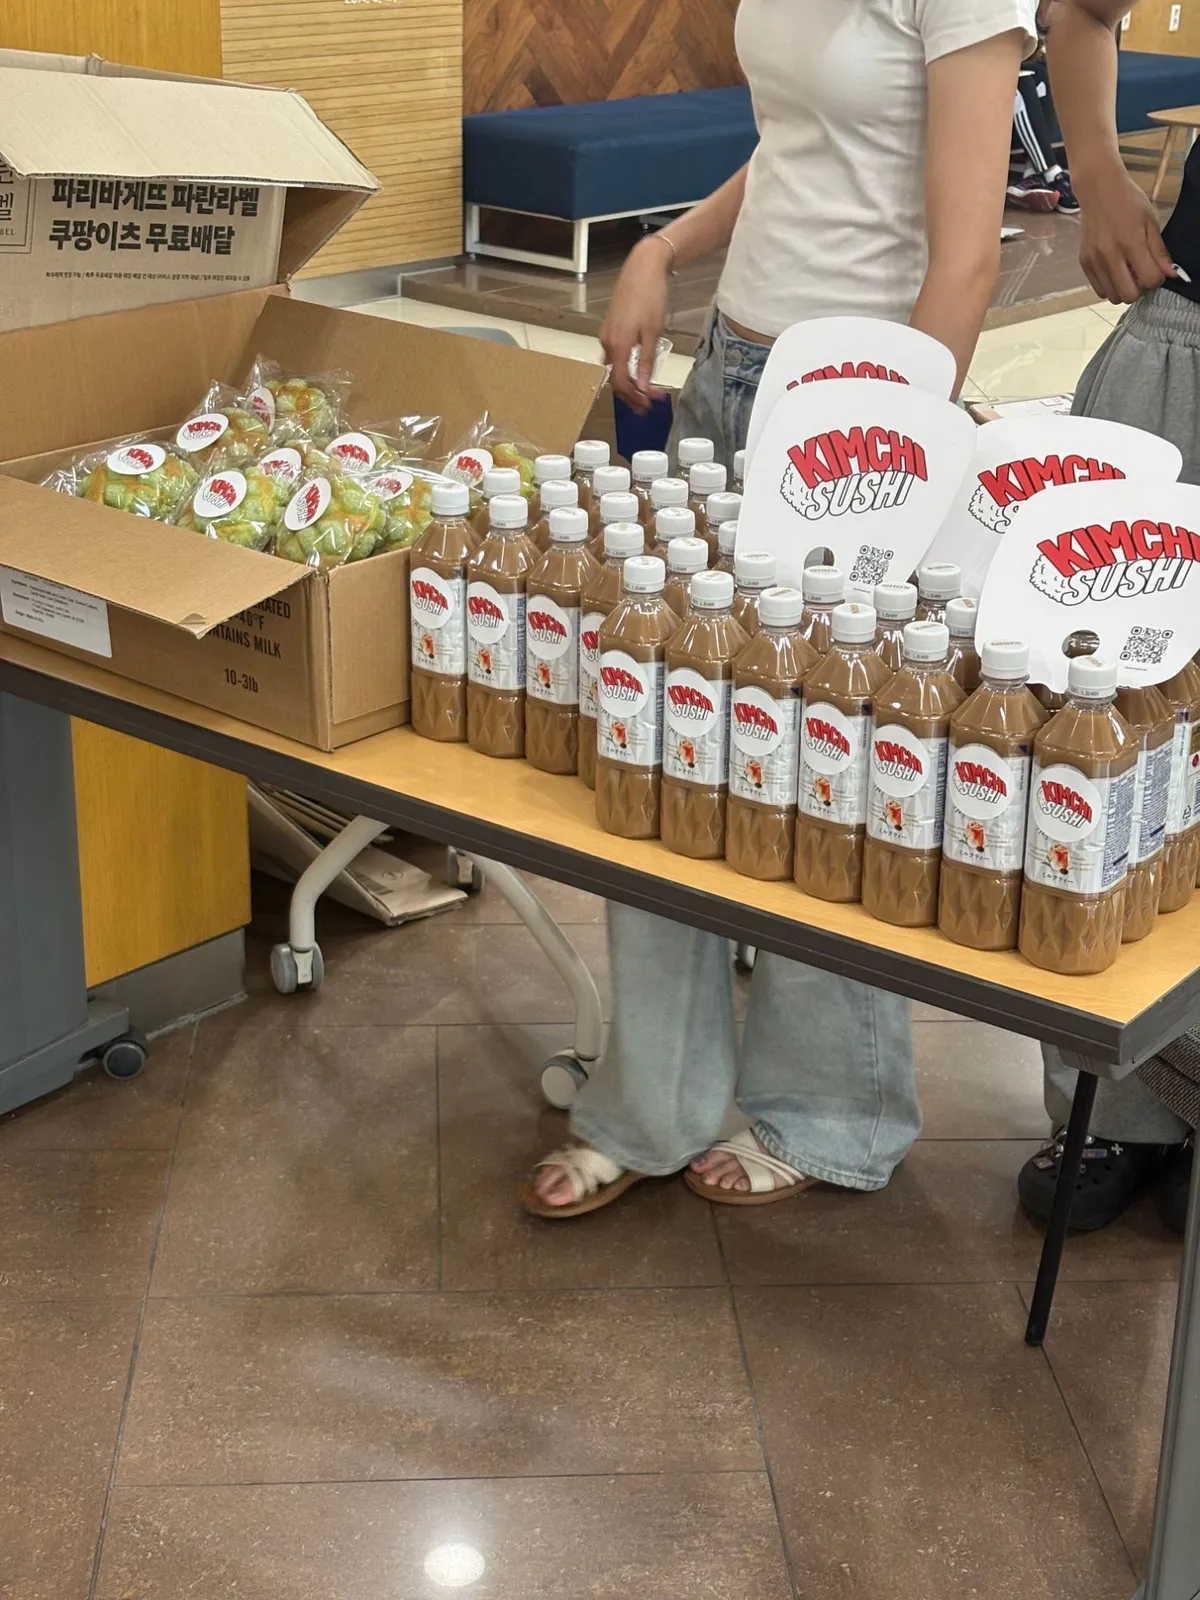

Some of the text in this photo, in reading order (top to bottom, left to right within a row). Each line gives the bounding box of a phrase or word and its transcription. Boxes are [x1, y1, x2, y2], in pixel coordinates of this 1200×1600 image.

[52, 179, 259, 217] 파리바게뜨 파란라벨
[49, 219, 235, 255] 쿠팡이츠 무료배달
[787, 426, 928, 489] KIMCHI
[805, 470, 915, 521] SUSHI
[1036, 519, 1200, 578] KIMCHI
[1060, 558, 1193, 607] SUSHI
[253, 635, 281, 659] MILK
[224, 667, 259, 693] 10-3lb
[733, 702, 779, 736] KIMCHI
[737, 721, 774, 742] SUSHI
[805, 717, 851, 757] KIMCHI
[808, 735, 846, 761] SUSHI
[874, 740, 923, 776] KIMCHI
[878, 760, 918, 782] SUSHI
[955, 761, 1008, 798] KIMCHI
[958, 781, 1002, 804] SUSHI
[1041, 780, 1093, 824] KIMCHI
[1042, 800, 1087, 829] SUSHI
